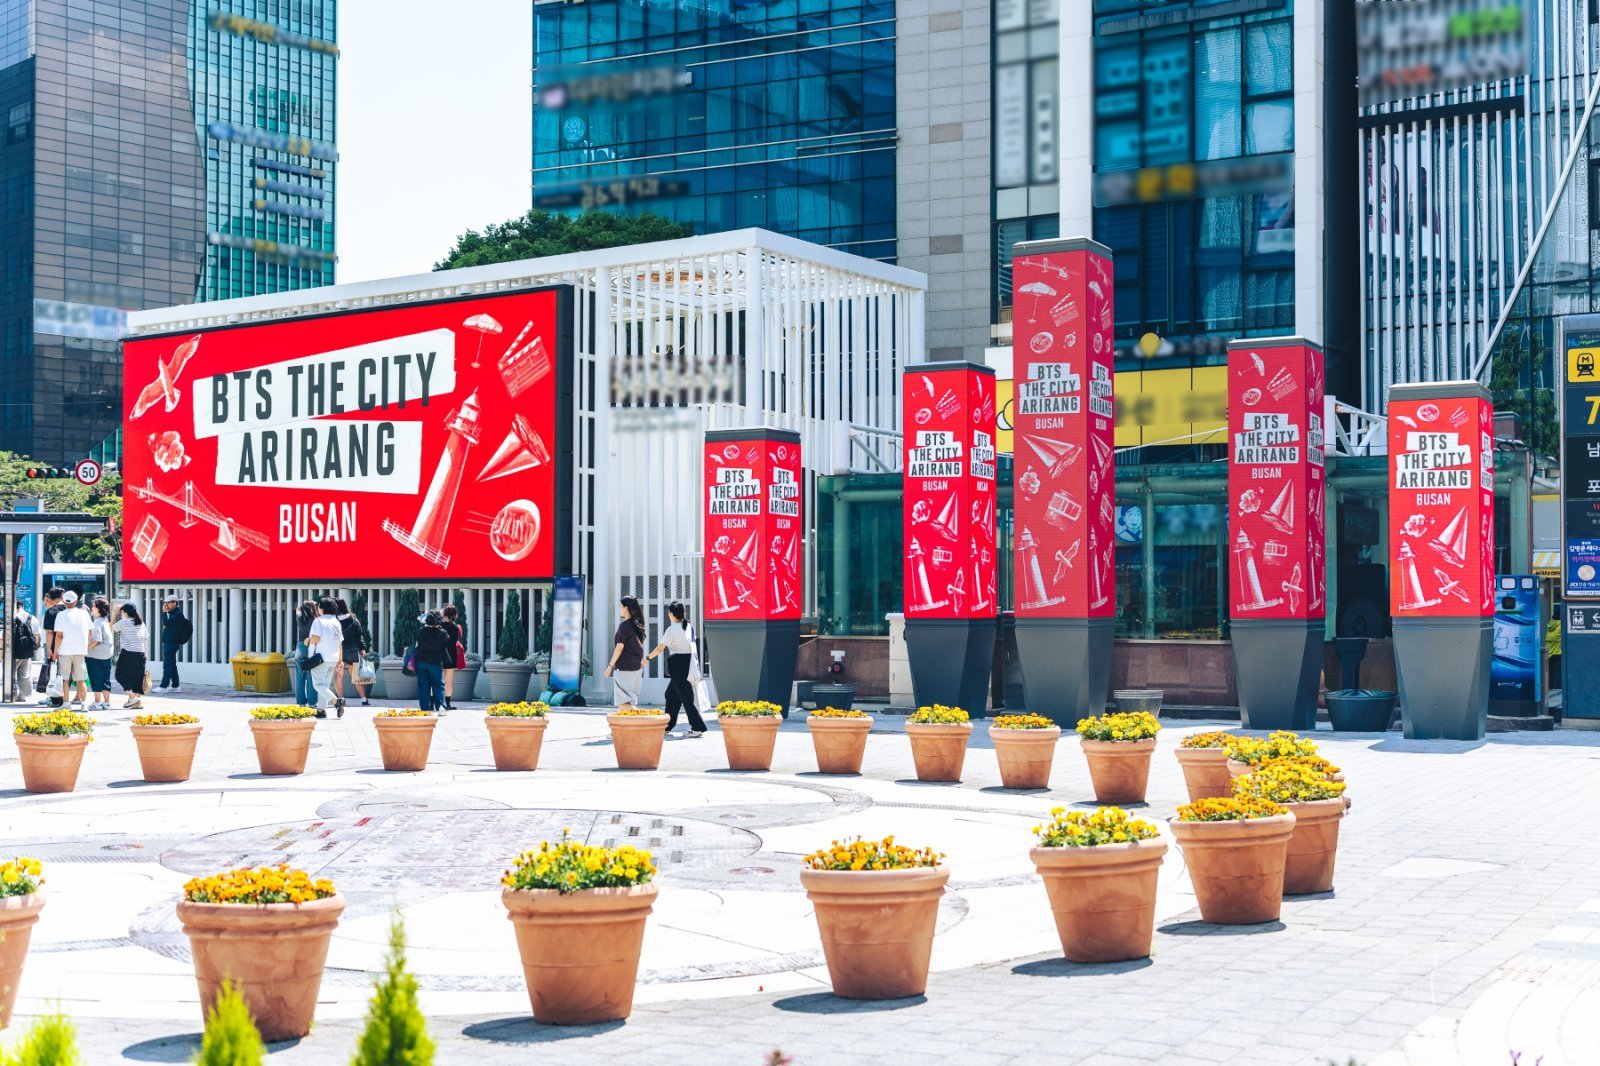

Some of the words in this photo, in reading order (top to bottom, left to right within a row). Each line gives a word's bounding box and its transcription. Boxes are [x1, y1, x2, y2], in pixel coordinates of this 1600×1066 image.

[1038, 365, 1061, 380] BTS
[212, 368, 273, 424] BTS
[287, 361, 345, 417] THE
[358, 351, 437, 412] CITY
[1025, 382, 1045, 396] THE
[1050, 380, 1075, 396] CITY
[1022, 397, 1078, 413] ARIRANG
[1585, 396, 1600, 424] 7
[1036, 418, 1064, 430] BUSAN
[1254, 415, 1278, 430] BTS
[925, 432, 946, 446] BTS
[1240, 432, 1262, 446] THE
[1266, 430, 1294, 446] CITY
[1419, 434, 1447, 450] BTS
[238, 421, 396, 484] ARIRANG
[914, 448, 932, 462] THE
[935, 446, 958, 460] CITY
[1238, 447, 1296, 462] ARIRANG
[1403, 454, 1428, 469] THE
[1433, 452, 1466, 468] CITY
[82, 466, 95, 478] 50
[724, 470, 744, 483] BTS
[911, 462, 960, 476] ARIRANG
[1252, 467, 1282, 479] BUSAN
[778, 470, 790, 484] BTS
[1400, 470, 1468, 488] ARIRANG
[714, 486, 732, 499] THE
[734, 484, 757, 498] CITY
[772, 485, 782, 499] THE
[784, 486, 796, 499] CITY
[922, 480, 948, 492] BUSAN
[1416, 492, 1450, 506] BUSAN
[712, 500, 758, 514] ARIRANG
[770, 501, 798, 514] ARIRANG
[279, 501, 357, 544] BUSAN
[722, 518, 746, 528] BUSAN
